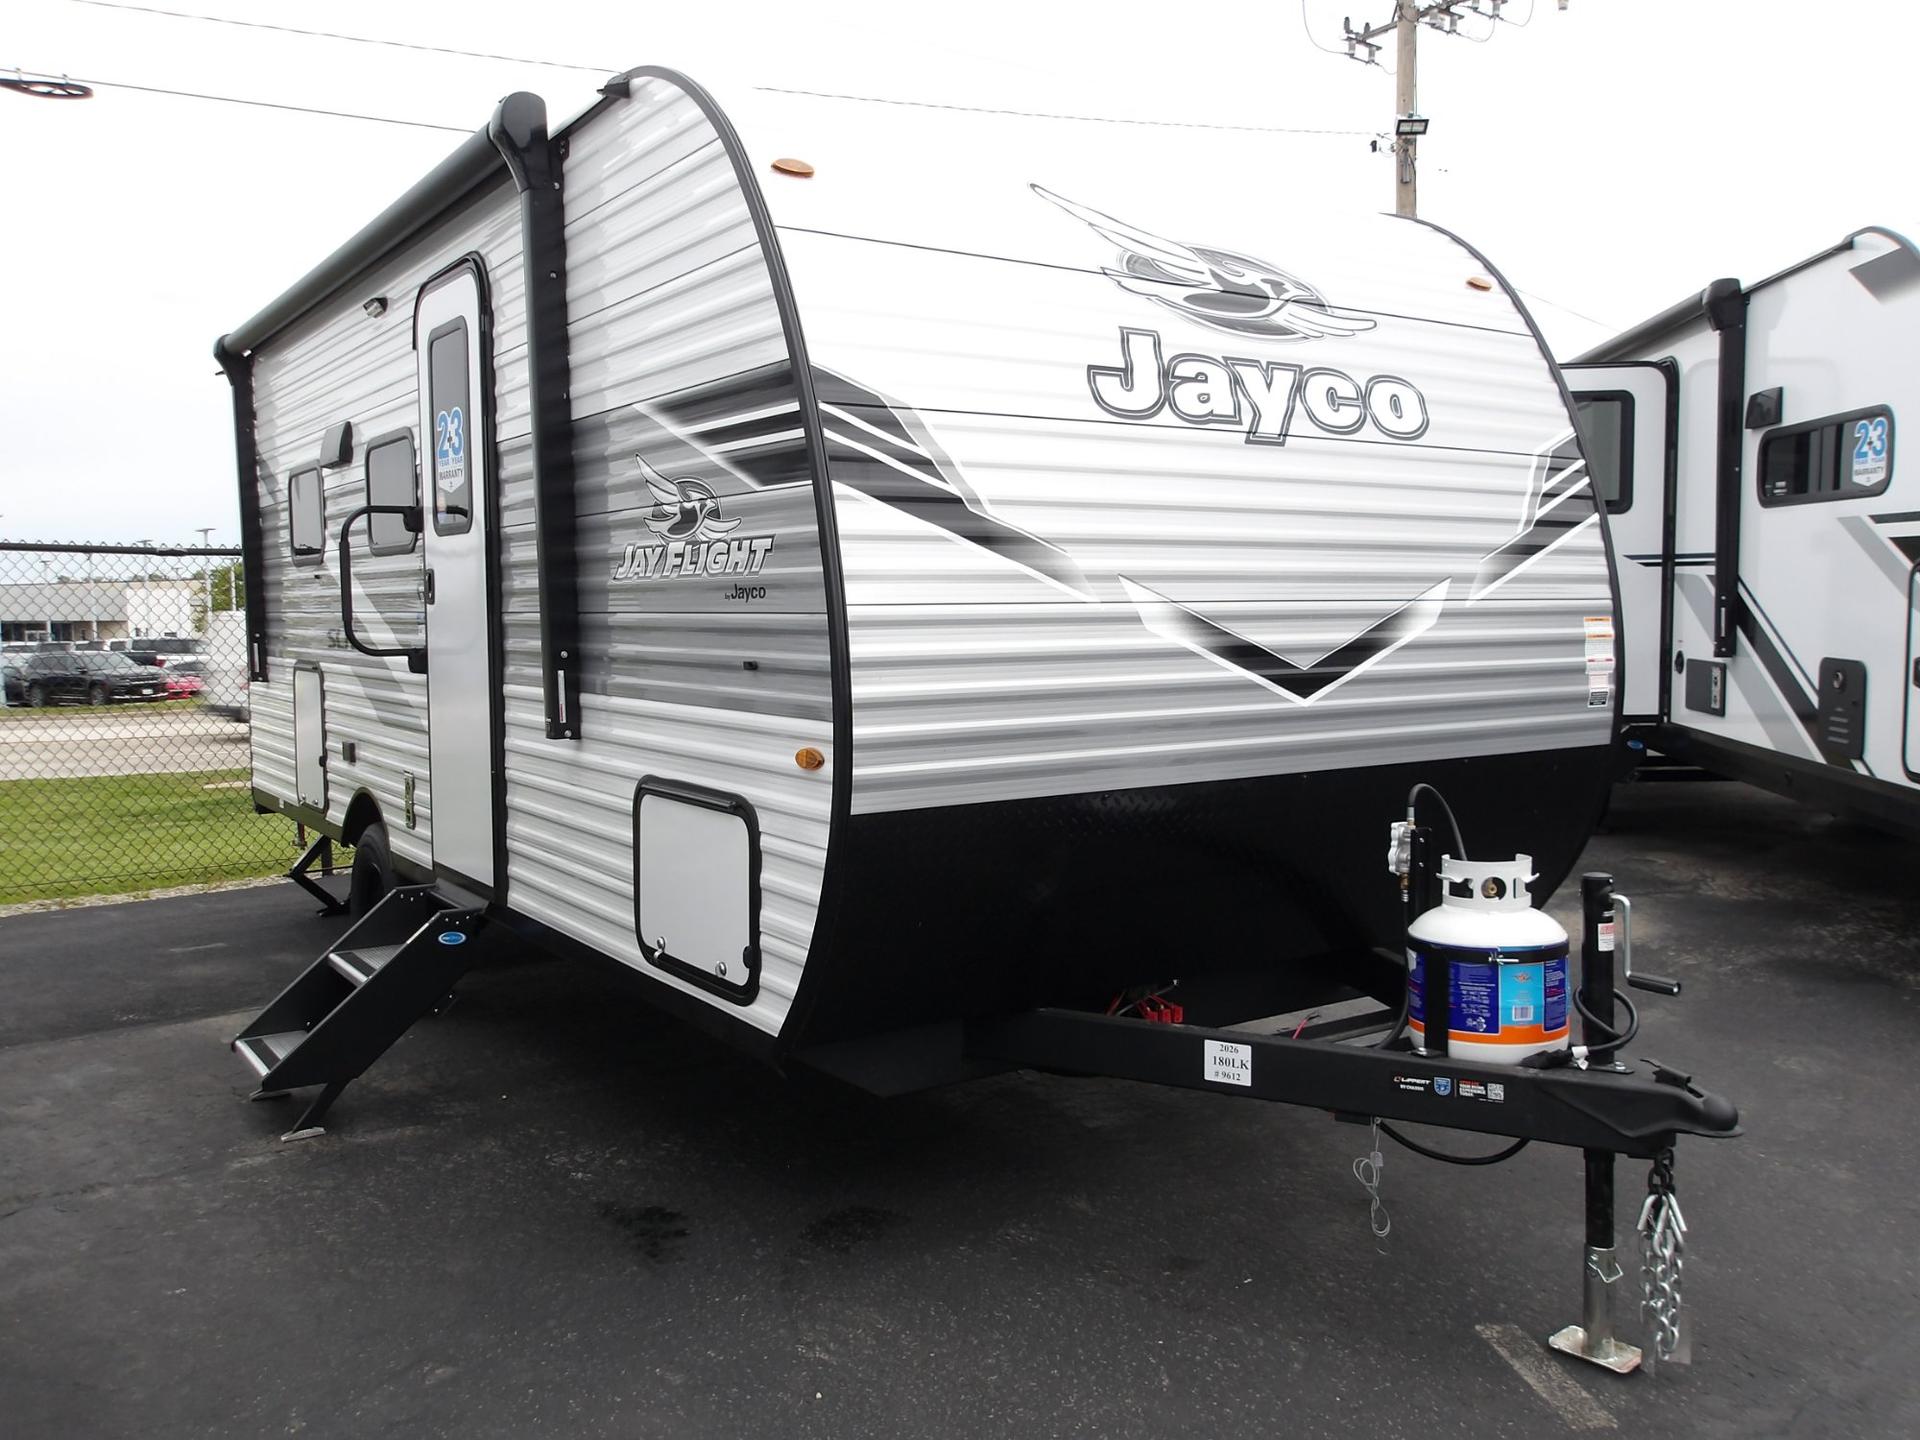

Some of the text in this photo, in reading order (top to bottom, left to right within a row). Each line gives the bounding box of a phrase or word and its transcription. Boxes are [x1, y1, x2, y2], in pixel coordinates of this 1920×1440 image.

[1086, 326, 1430, 446] Jayco
[439, 468, 463, 481] WARRANTY
[614, 535, 776, 580] JAY FLIGHT
[731, 583, 767, 603] Jayco
[1220, 1044, 1239, 1054] 2026
[1213, 1056, 1248, 1070] 180LK
[1221, 1071, 1241, 1081] 9612
